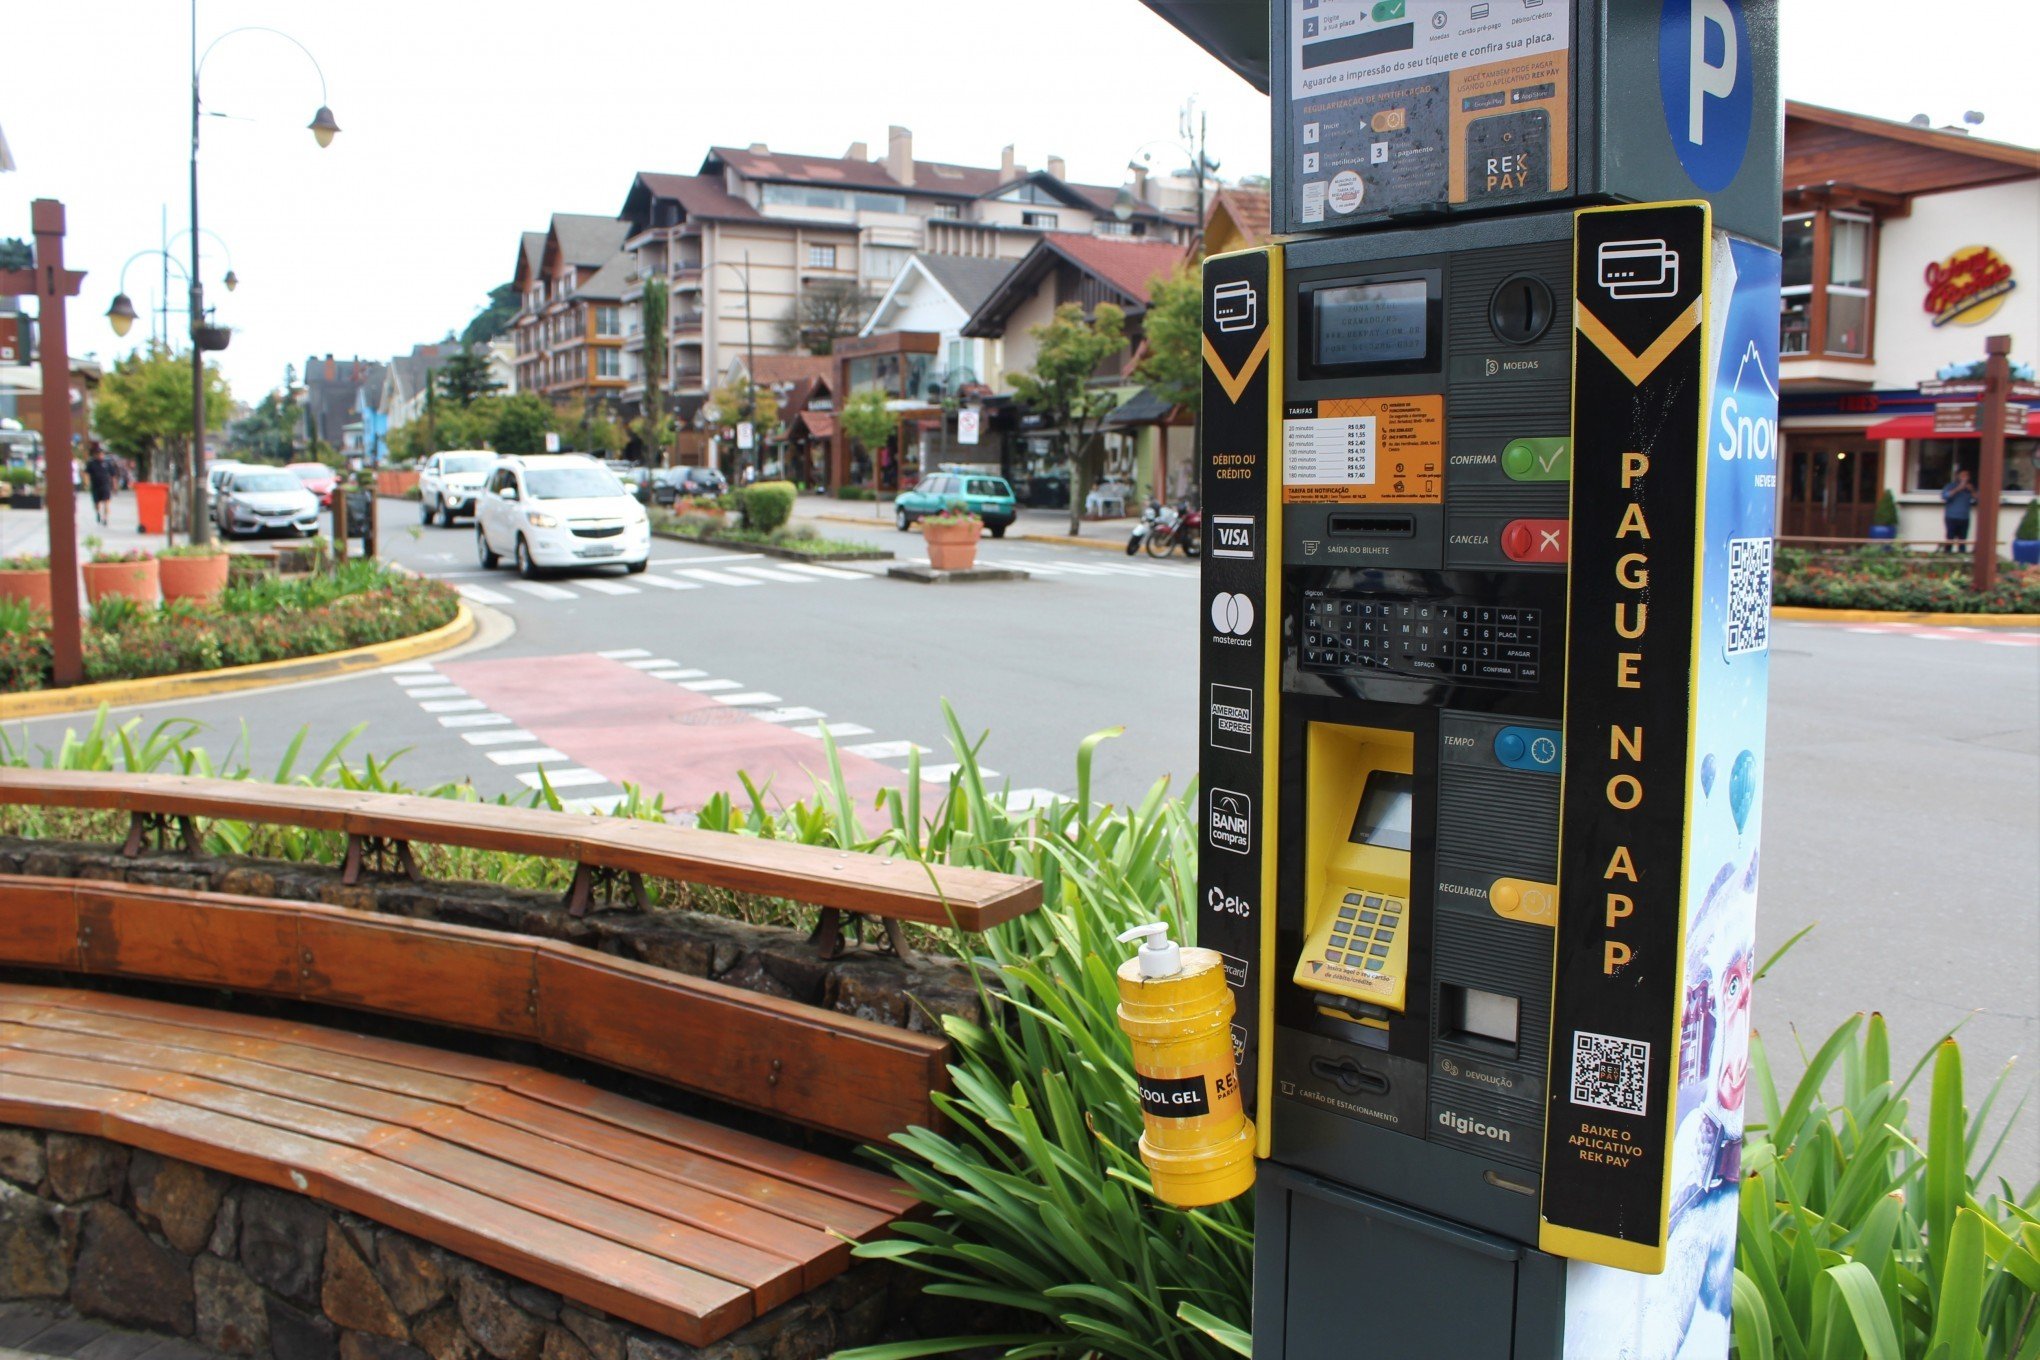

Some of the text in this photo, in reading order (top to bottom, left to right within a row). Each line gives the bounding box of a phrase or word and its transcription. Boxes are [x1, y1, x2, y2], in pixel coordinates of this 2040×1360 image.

[1323, 14, 1340, 24] Digite
[1340, 19, 1355, 30] placa
[1512, 12, 1552, 25] Débito/Crédito
[1308, 23, 1314, 32] 2
[1458, 22, 1501, 36] Cartão pré-pago
[1430, 33, 1450, 41] Moedas
[1302, 75, 1337, 89] Aguarde
[1346, 63, 1391, 81] impressão
[1394, 61, 1405, 71] do
[1407, 60, 1422, 69] seu
[1425, 52, 1458, 66] tíquete
[1461, 50, 1467, 58] e
[1470, 43, 1503, 56] confira
[1506, 39, 1523, 49] sua
[1526, 32, 1555, 48] placa.
[1464, 60, 1553, 83] VOCÊ TAMBÉM PODE PAGAR
[1689, 0, 1738, 146] P
[1458, 83, 1484, 92] USANDO
[1492, 73, 1530, 86] APLICATIVO
[1546, 69, 1559, 77] PAY
[1308, 128, 1313, 138] 1
[1376, 148, 1382, 158] 3
[1398, 146, 1434, 157] pagamento
[1308, 159, 1313, 168] 2
[1487, 152, 1528, 175] REK
[1487, 171, 1528, 191] PAY
[1503, 361, 1538, 370] MOEDAS
[1212, 453, 1256, 465] DÉBITO OU
[1450, 454, 1497, 465] CONFIRMA
[1216, 468, 1251, 479] CRÉDITO
[1314, 486, 1349, 494] NOTIFICAÇÃO
[1218, 528, 1249, 546] VISA
[1450, 535, 1489, 544] CANCELA
[1328, 544, 1348, 553] SAÍDA
[1213, 635, 1252, 646] mastercard
[1212, 705, 1248, 719] AMERICAN
[1603, 452, 1650, 975] PAGUE NO APP
[1219, 720, 1251, 733] EXPRESS
[1444, 736, 1474, 747] TEMPO
[1213, 813, 1247, 834] BANRI
[1213, 830, 1247, 846] compras
[1439, 882, 1487, 899] REGULARIZA
[1225, 895, 1250, 917] elo
[1224, 965, 1244, 978] ercard
[1326, 964, 1342, 973] Insira
[1372, 973, 1389, 982] cartão
[1332, 973, 1372, 986] débito/crédito
[1466, 1070, 1512, 1088] DEVOLUÇÃO
[1140, 1086, 1200, 1104] COOL GEL
[1300, 1089, 1398, 1123] CARTÃO DE ESTACIONAMENTO
[1439, 1111, 1510, 1142] digicon
[1581, 1123, 1631, 1141] BAIXE O
[1568, 1134, 1642, 1156] APLICATIVO
[1580, 1150, 1629, 1168] REK PAY
